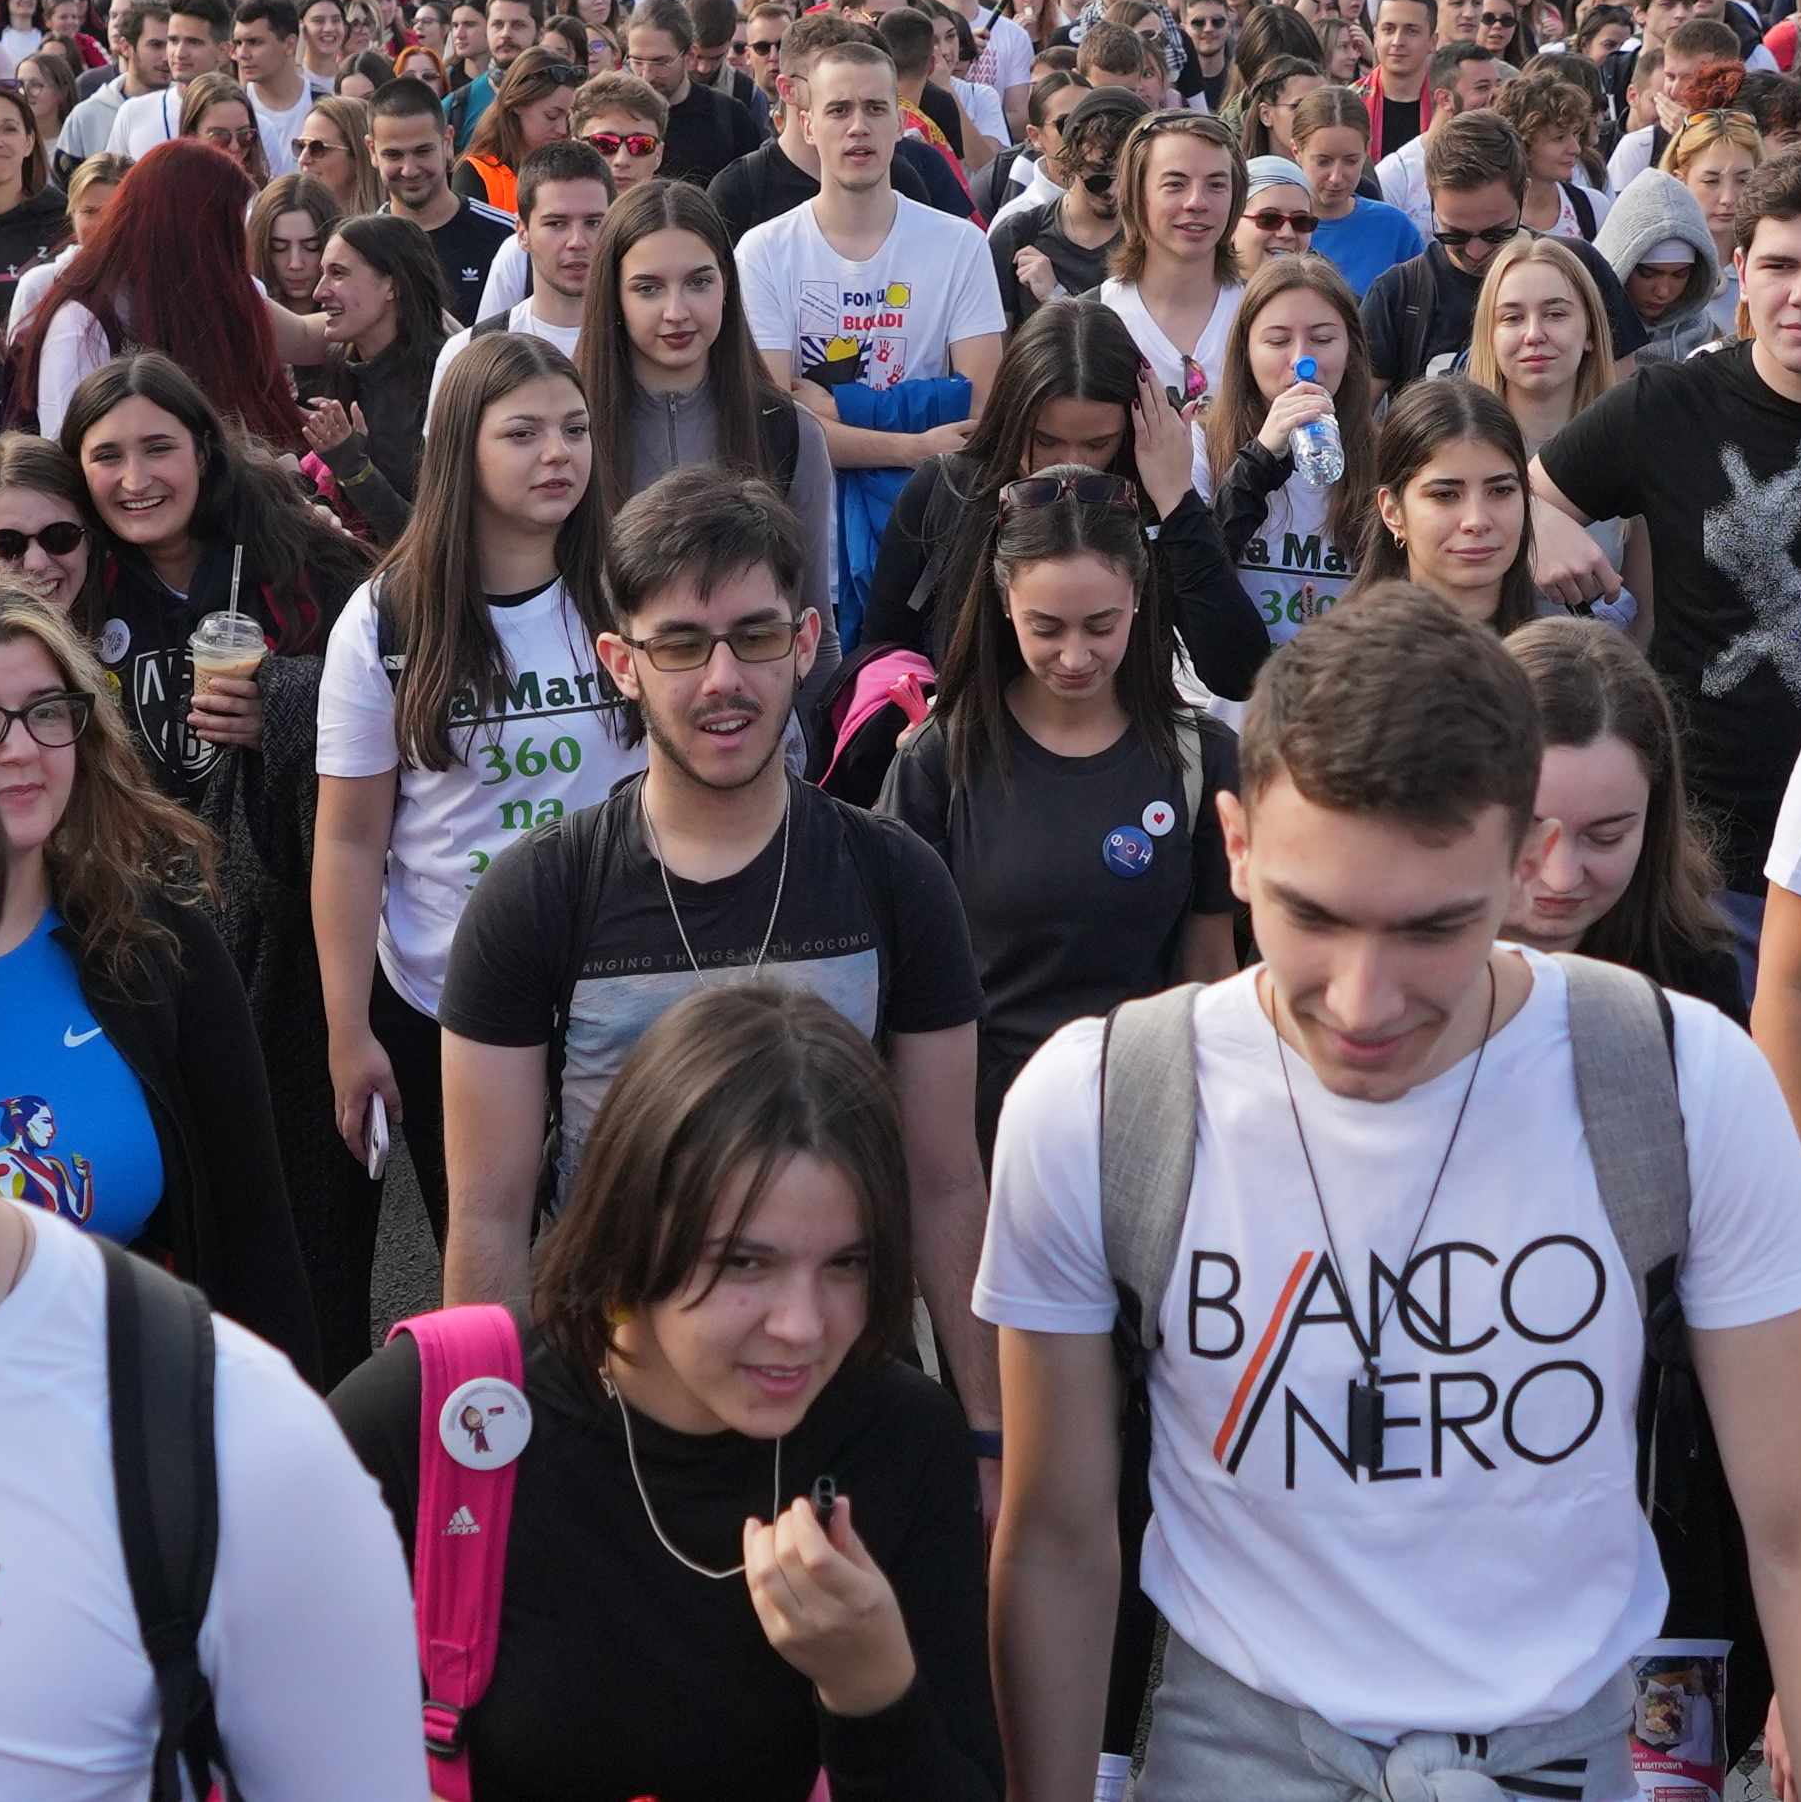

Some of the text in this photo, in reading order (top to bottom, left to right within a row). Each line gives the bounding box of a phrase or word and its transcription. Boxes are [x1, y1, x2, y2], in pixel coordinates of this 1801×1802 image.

[1282, 532, 1348, 573] Ma
[477, 736, 582, 786] 360
[581, 957, 653, 974] ANGING
[801, 931, 871, 954] COCOMO
